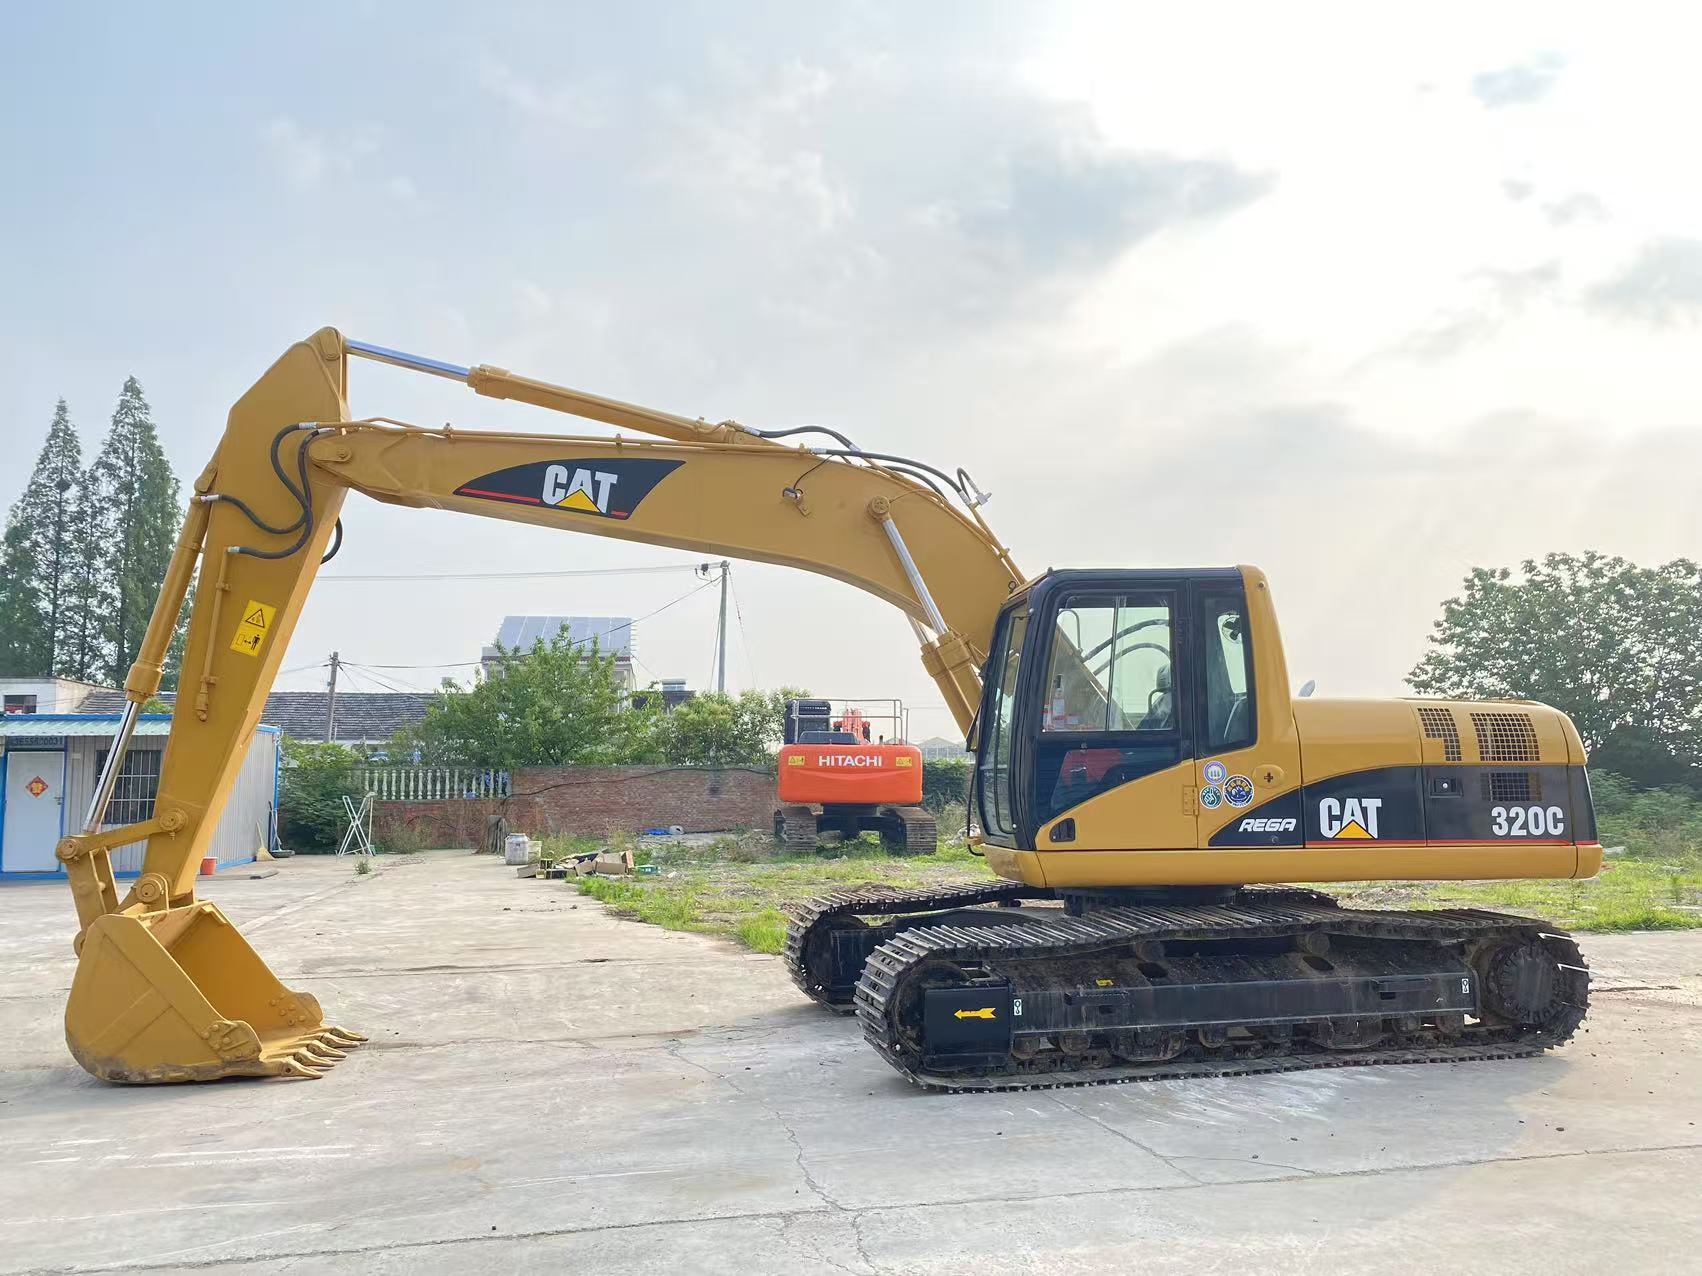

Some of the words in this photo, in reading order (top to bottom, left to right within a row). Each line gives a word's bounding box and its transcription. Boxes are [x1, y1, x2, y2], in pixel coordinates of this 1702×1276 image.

[542, 464, 618, 514] CAT
[818, 755, 883, 767] HITACHI
[1238, 818, 1297, 832] REGA
[1319, 797, 1382, 839] CAT
[1491, 806, 1564, 836] 320C
